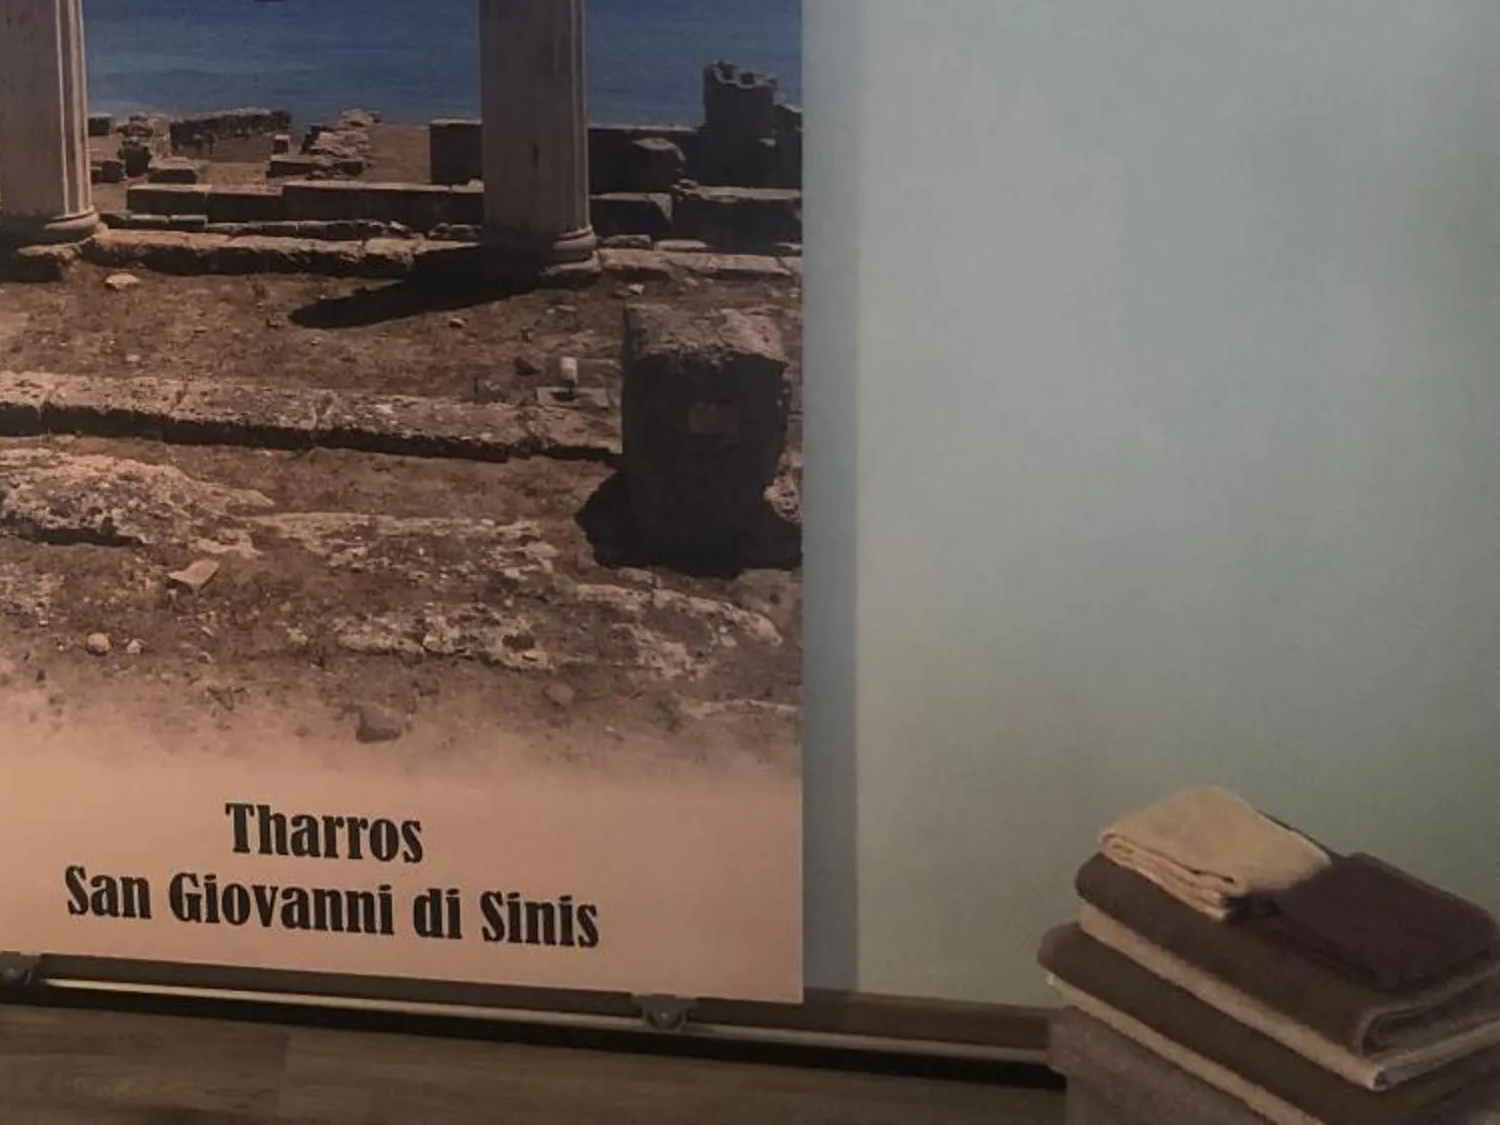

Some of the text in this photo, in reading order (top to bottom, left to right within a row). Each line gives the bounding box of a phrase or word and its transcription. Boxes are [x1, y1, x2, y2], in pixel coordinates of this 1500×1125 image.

[225, 802, 424, 864] Tharros
[64, 865, 600, 949] San Giovanni di Sinis
